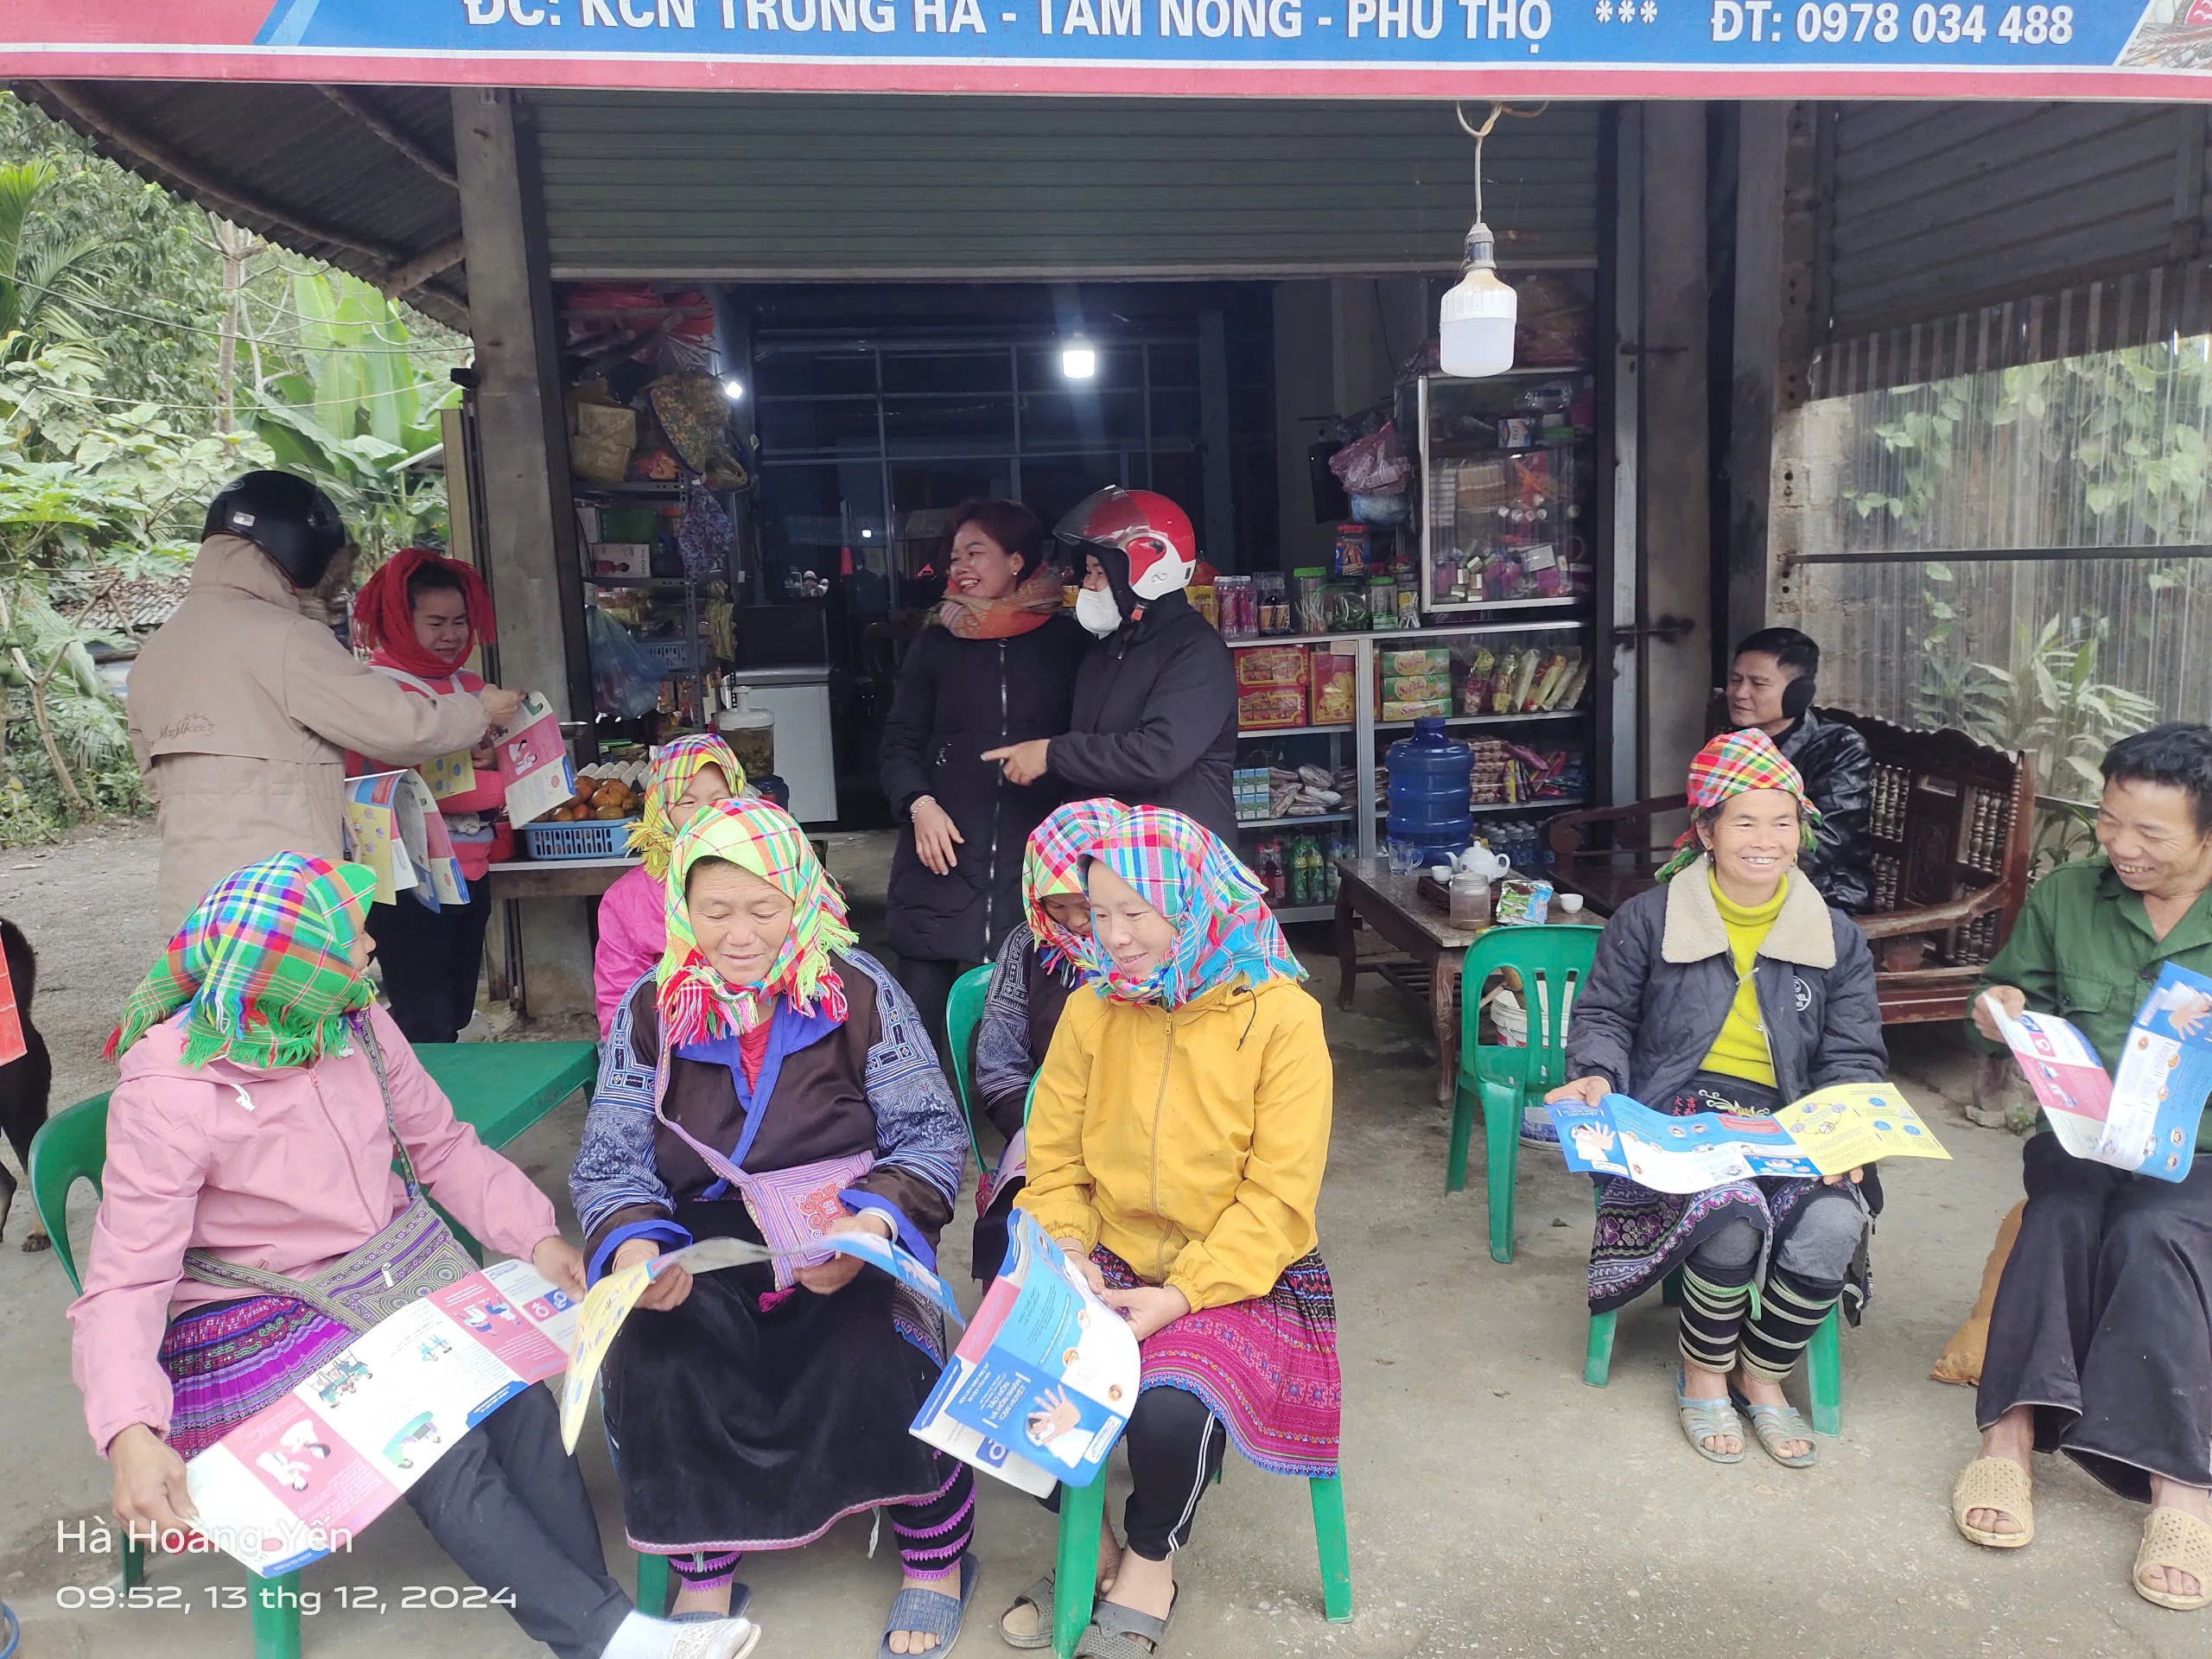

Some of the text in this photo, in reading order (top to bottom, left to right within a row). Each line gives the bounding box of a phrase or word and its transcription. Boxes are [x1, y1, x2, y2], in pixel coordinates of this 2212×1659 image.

[581, 0, 696, 29] KCN
[721, 0, 895, 34] TRUNG
[1710, 0, 1782, 42] ĐT:
[1796, 3, 1899, 43] 0978
[1911, 3, 1986, 44] 034
[1999, 4, 2074, 45] 488
